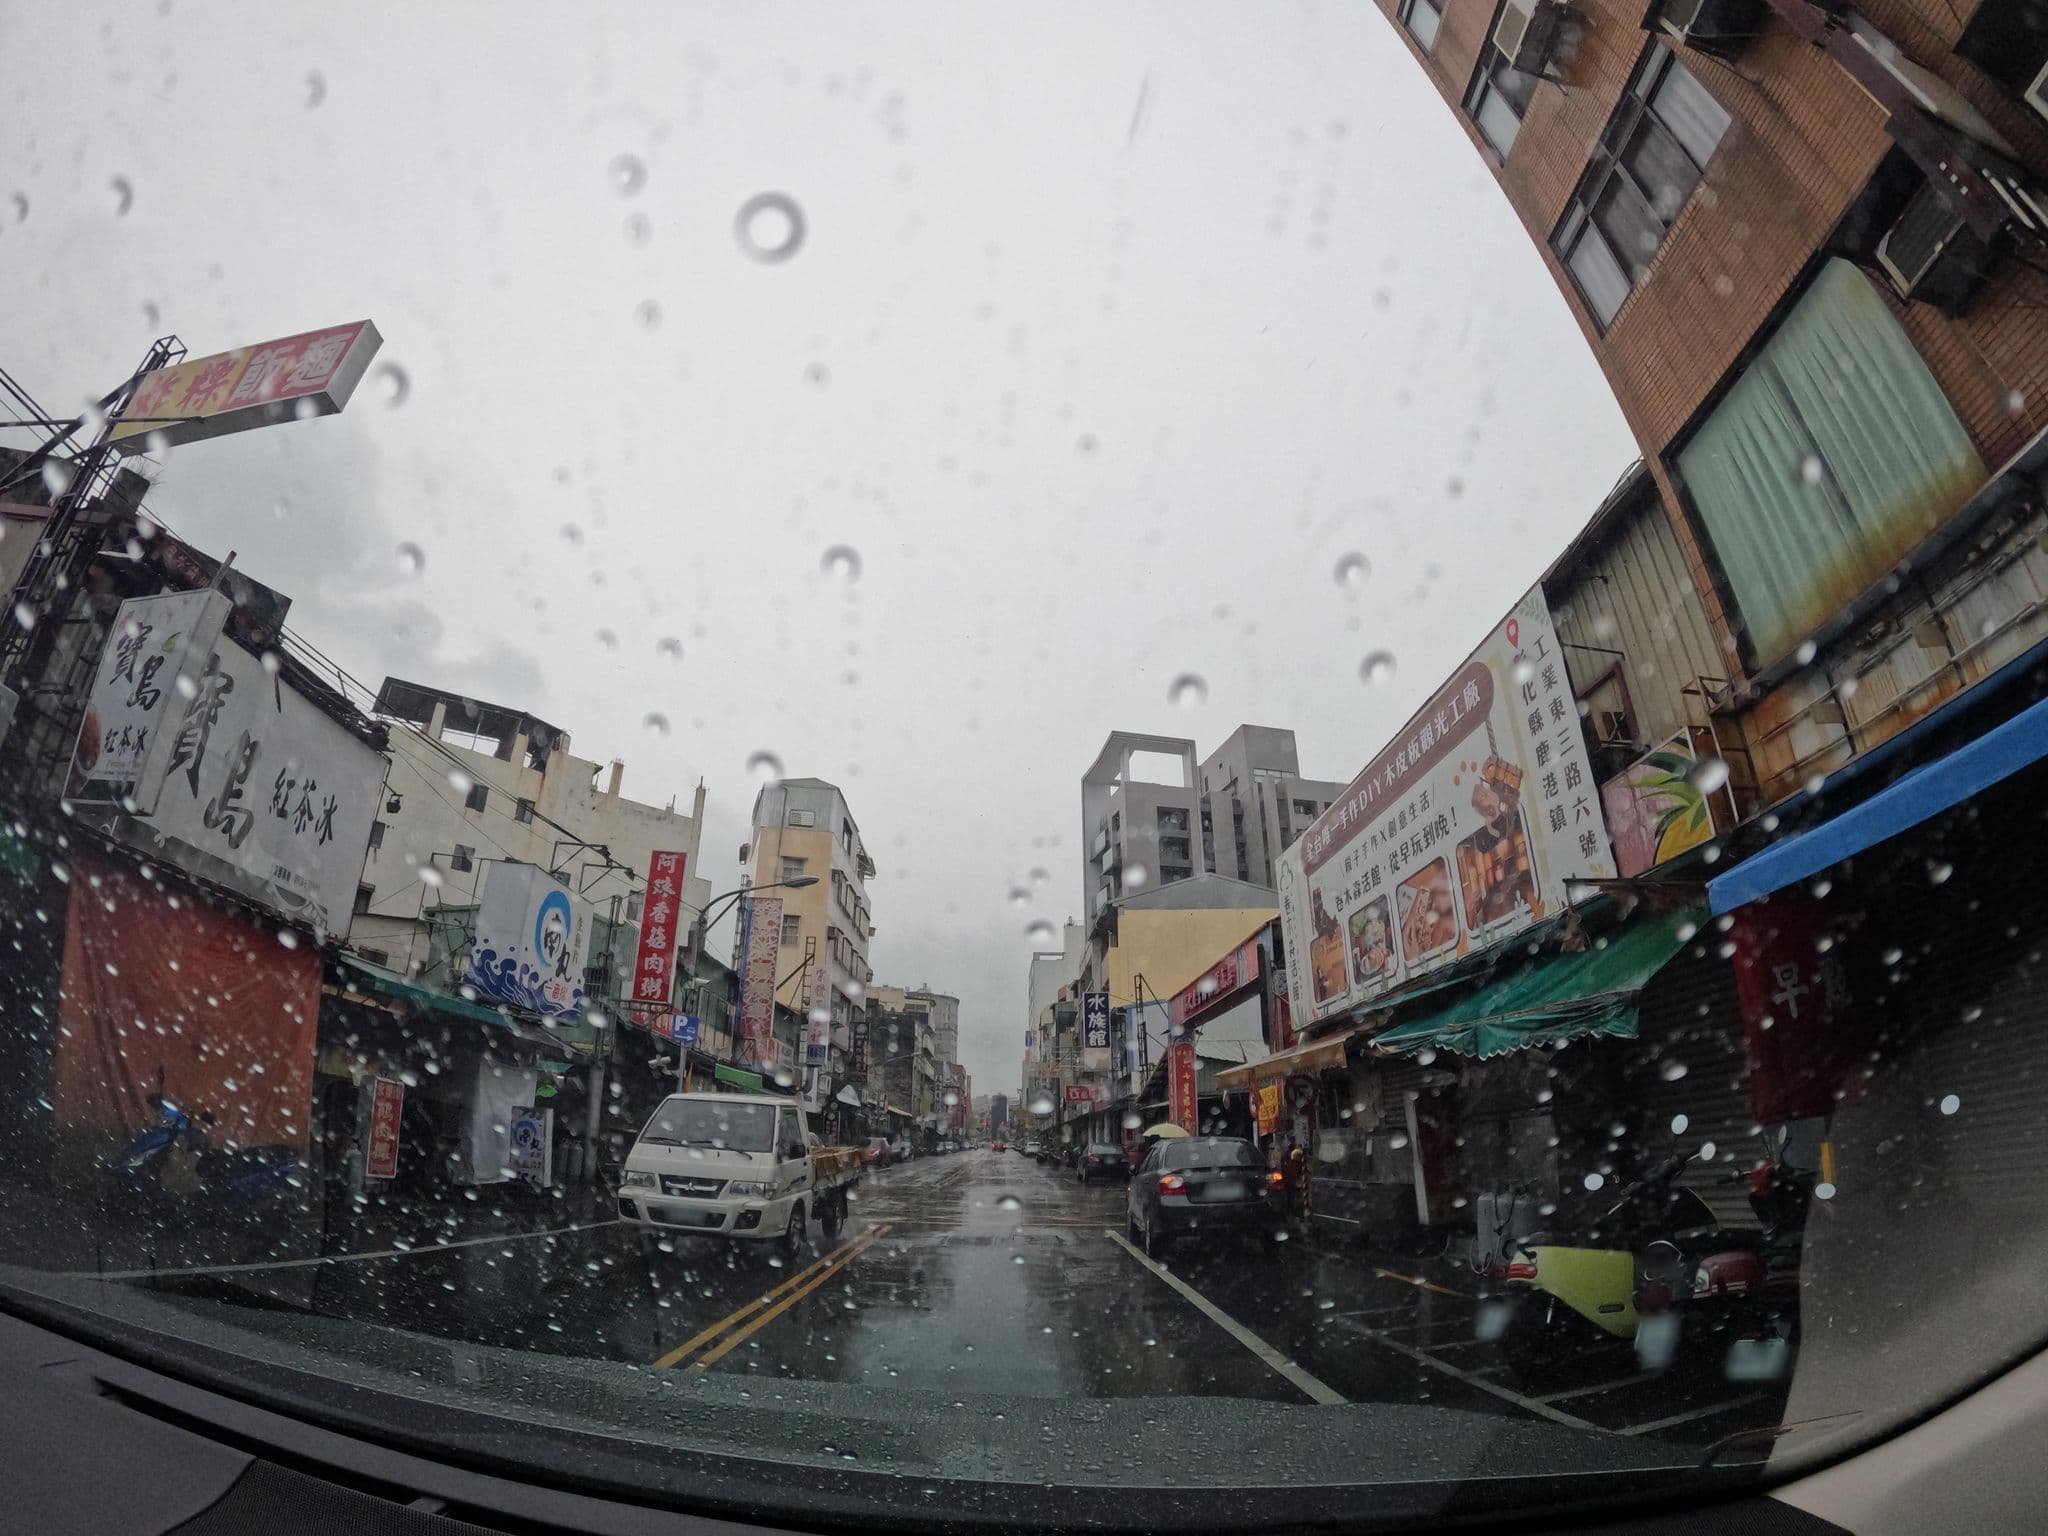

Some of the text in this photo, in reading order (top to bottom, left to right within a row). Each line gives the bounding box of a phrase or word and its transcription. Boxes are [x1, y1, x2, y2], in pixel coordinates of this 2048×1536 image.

[103, 723, 148, 759] 紅茶冰
[167, 652, 259, 850] 寶島
[1514, 648, 1568, 833] 化縣鹿港鎮
[1533, 634, 1600, 859] 工業東三路六號
[269, 766, 338, 847] 紅茶冰
[674, 1014, 687, 1032] P
[1087, 993, 1107, 1047] 水族館
